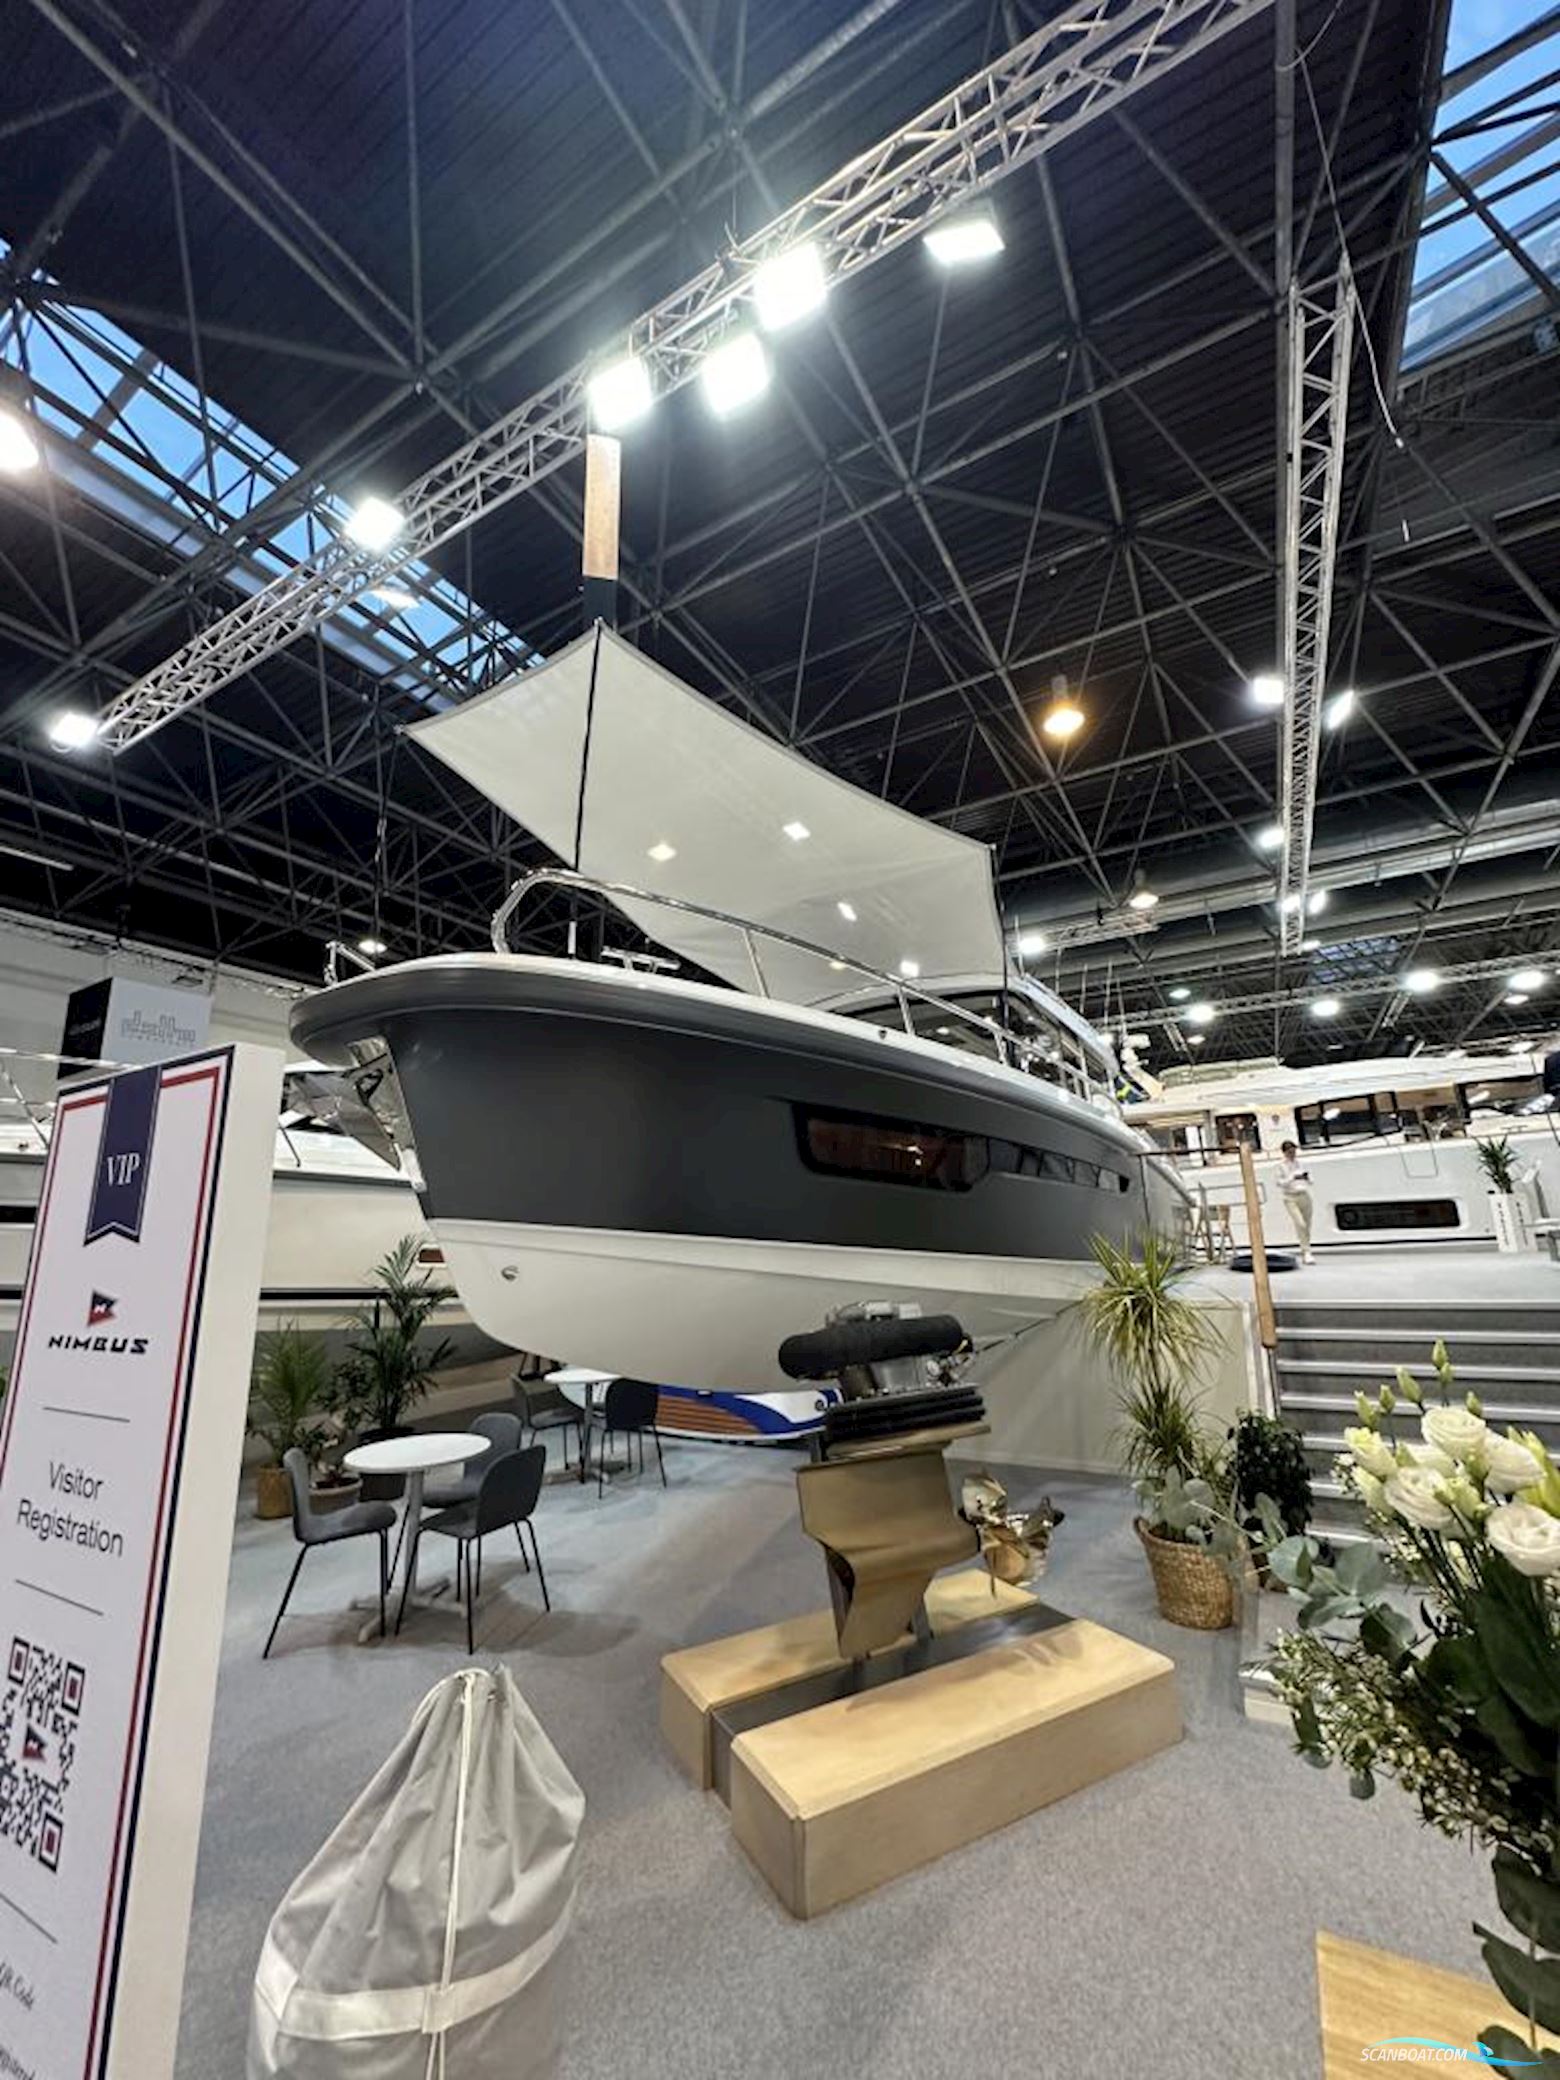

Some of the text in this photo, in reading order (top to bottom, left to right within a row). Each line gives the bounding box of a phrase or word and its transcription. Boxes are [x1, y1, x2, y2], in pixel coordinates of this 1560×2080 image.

[106, 1152, 141, 1187] VIP
[48, 1335, 150, 1355] NIMBUS
[49, 1460, 104, 1500] Visitor
[16, 1498, 123, 1558] Registration
